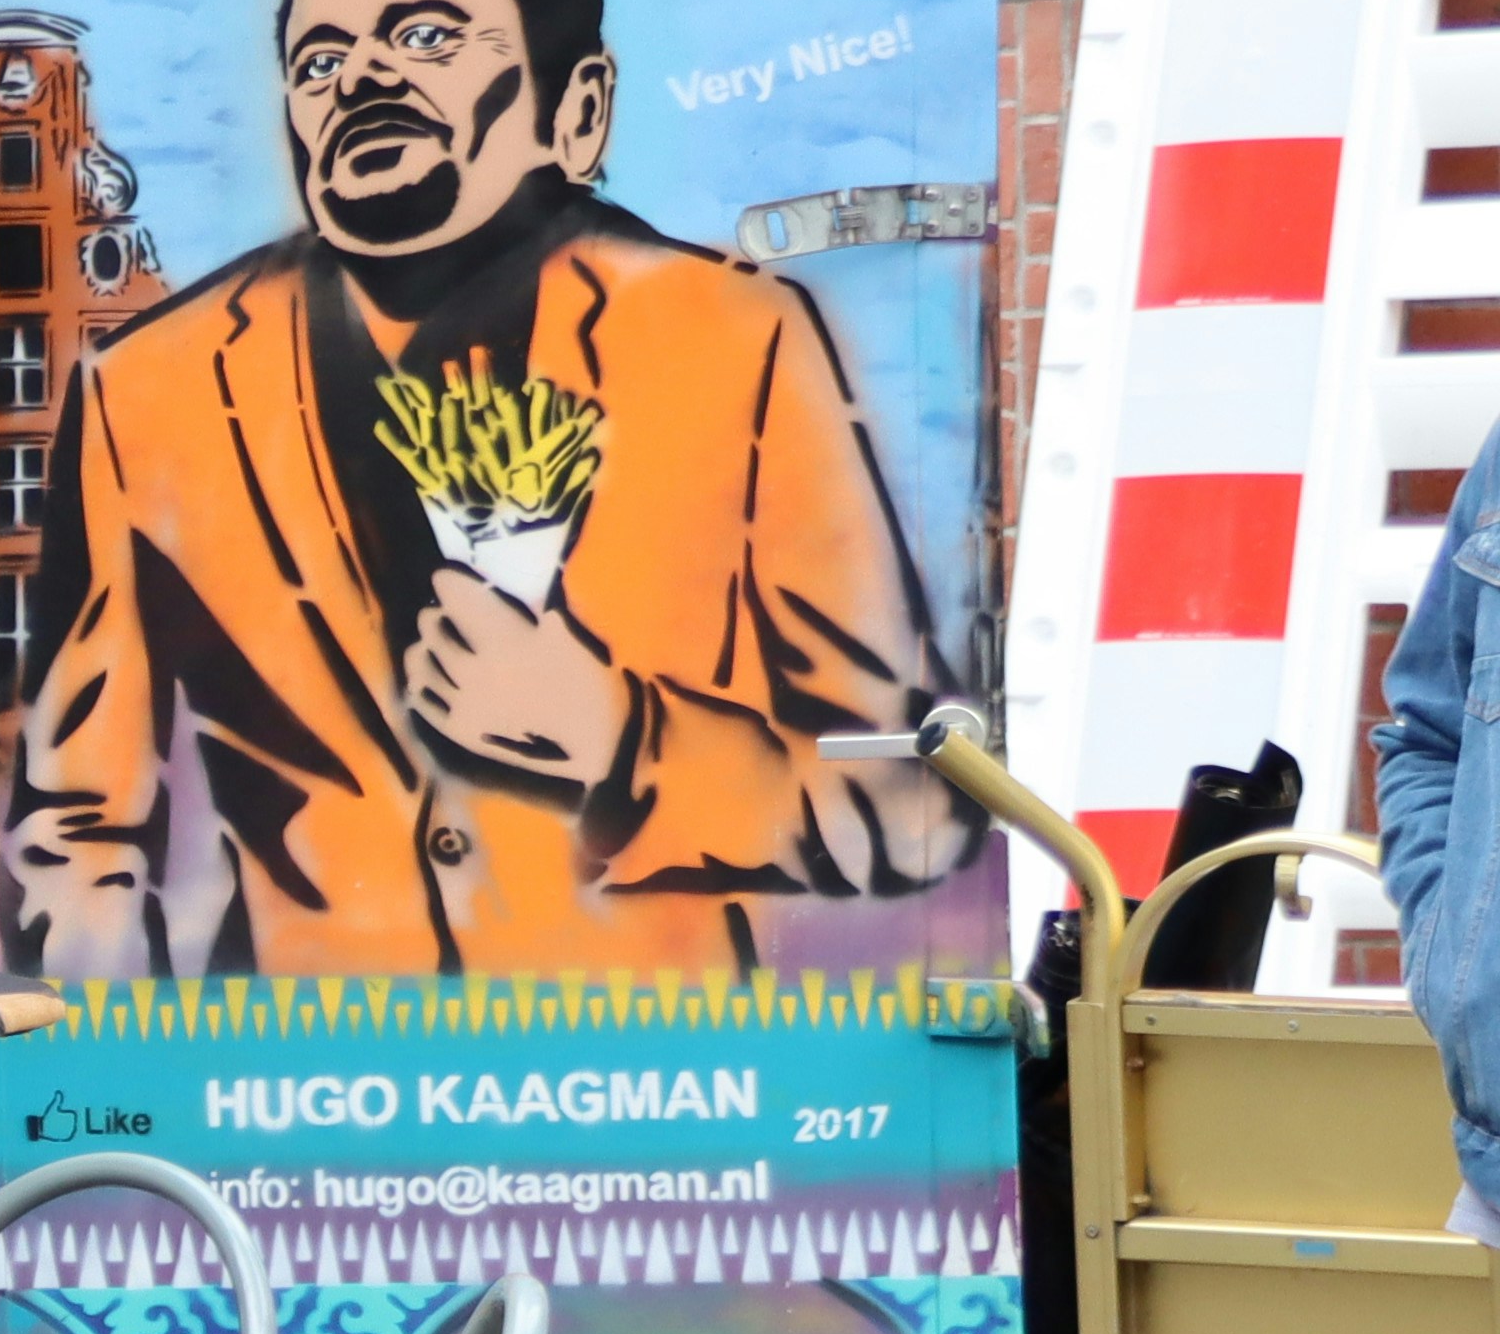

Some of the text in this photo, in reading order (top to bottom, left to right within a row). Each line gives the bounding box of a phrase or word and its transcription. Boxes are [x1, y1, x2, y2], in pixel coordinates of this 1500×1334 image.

[665, 12, 915, 112] Very Nice!
[84, 1104, 153, 1138] Like
[205, 1069, 760, 1131] HUGO KAAGMAN
[792, 1105, 891, 1144] 2017
[313, 1161, 770, 1217] hugo@kaagman.nl
